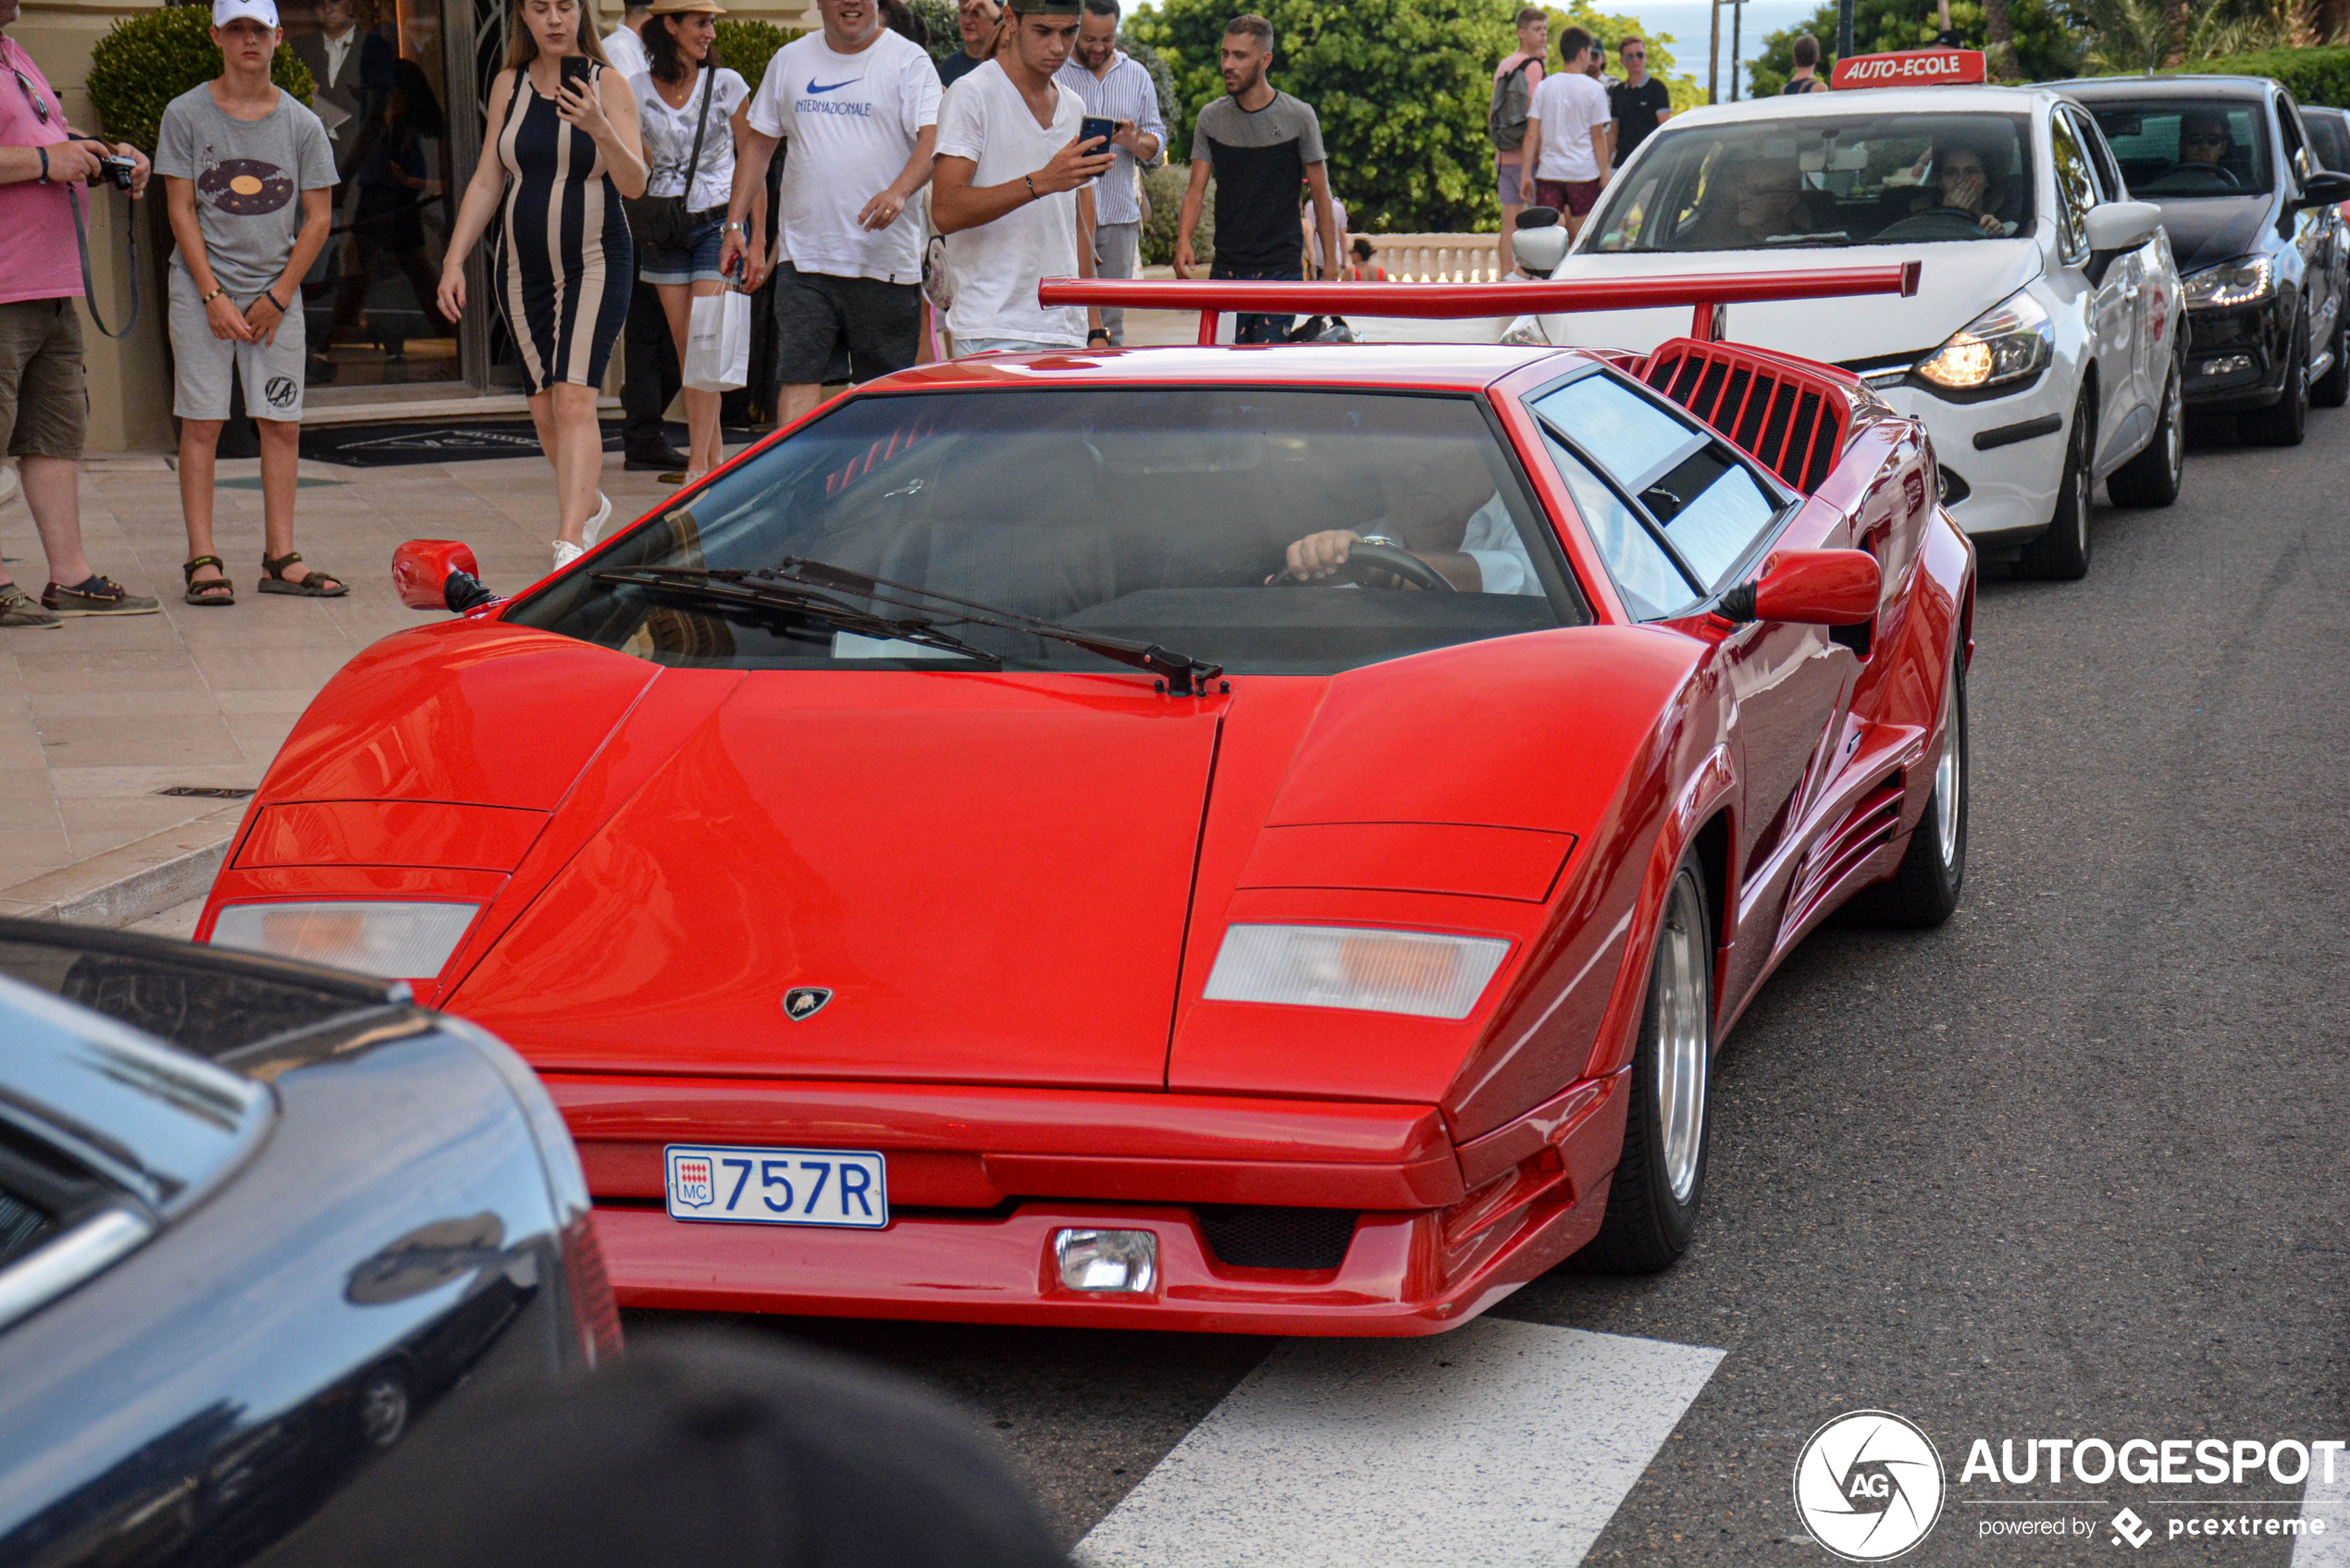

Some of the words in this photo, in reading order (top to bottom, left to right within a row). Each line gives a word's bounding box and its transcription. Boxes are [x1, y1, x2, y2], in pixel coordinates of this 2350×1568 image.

[1844, 56, 1960, 80] AUTO-ECOLE
[796, 99, 872, 117] INTERNAZIONALE
[683, 1184, 708, 1200] MC
[722, 1158, 872, 1216] 757R
